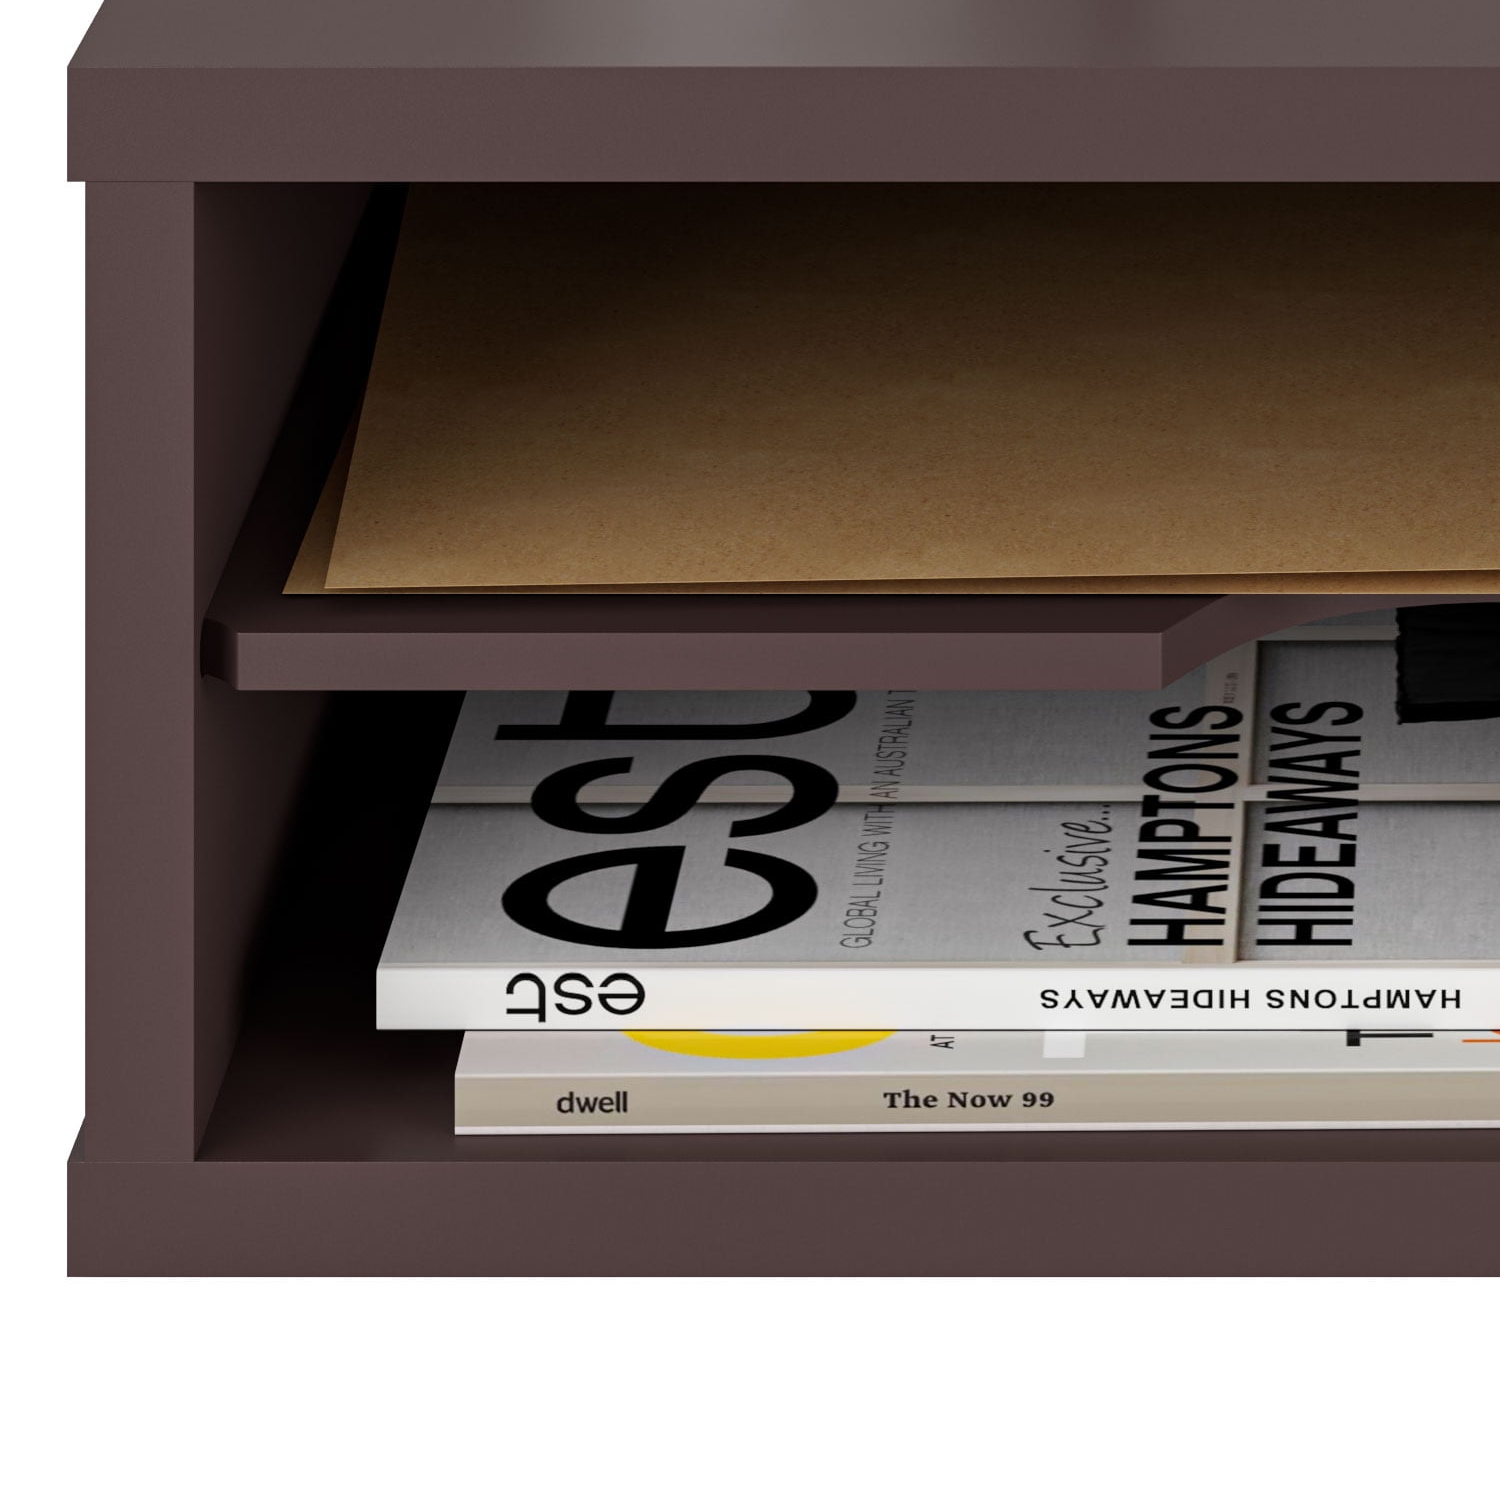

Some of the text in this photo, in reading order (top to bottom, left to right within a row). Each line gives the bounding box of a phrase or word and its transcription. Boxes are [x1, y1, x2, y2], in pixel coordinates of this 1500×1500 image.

[872, 699, 916, 777] AUSTRALIAN
[868, 781, 901, 799] AN
[860, 803, 896, 836] WITH
[1127, 705, 1244, 946] HAMPTONS
[1255, 701, 1364, 946] HIDEAWAYS
[851, 841, 891, 886] LIVING
[839, 890, 882, 948] GLOBAL
[505, 972, 646, 1023] est
[1039, 988, 1461, 1010] HAMPTONS HIDEAWAYS
[555, 1091, 629, 1114] dwell
[883, 1090, 1056, 1109] The Now 99
